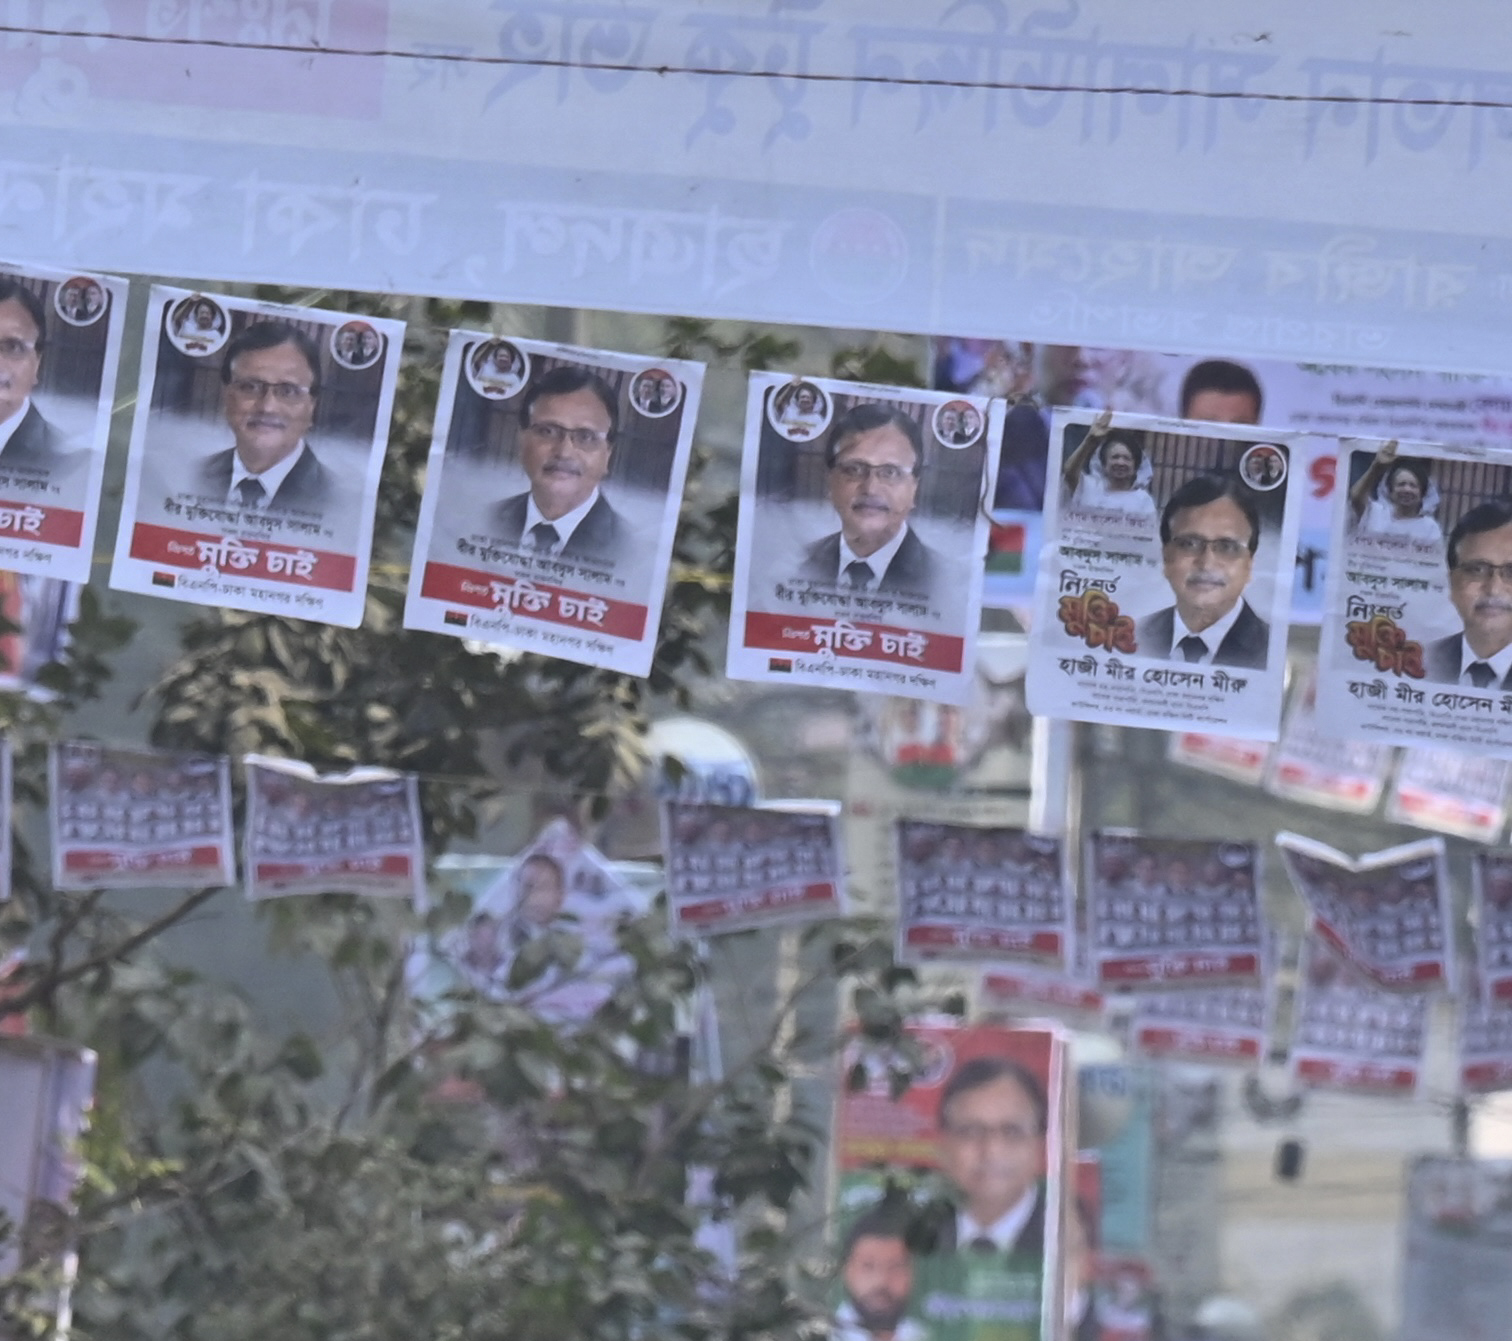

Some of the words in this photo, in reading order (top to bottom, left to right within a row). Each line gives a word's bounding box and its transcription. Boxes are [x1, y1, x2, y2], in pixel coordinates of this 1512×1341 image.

[197, 534, 257, 577] মুক্তি
[264, 546, 316, 580] চাই
[1059, 569, 1121, 594] নিঃশর্ত
[490, 576, 551, 619] মুক্তি
[556, 591, 608, 627] চাই
[1345, 595, 1407, 620] নিঃশর্ত
[811, 618, 870, 663] মুক্তি
[878, 630, 928, 663] চাই
[1058, 655, 1098, 676] হাজী
[1104, 657, 1136, 680] মীর
[1143, 667, 1204, 689] হোসেন
[1346, 679, 1388, 700] হাজী
[1394, 681, 1426, 704] মীর
[1431, 692, 1493, 712] হোসেন
